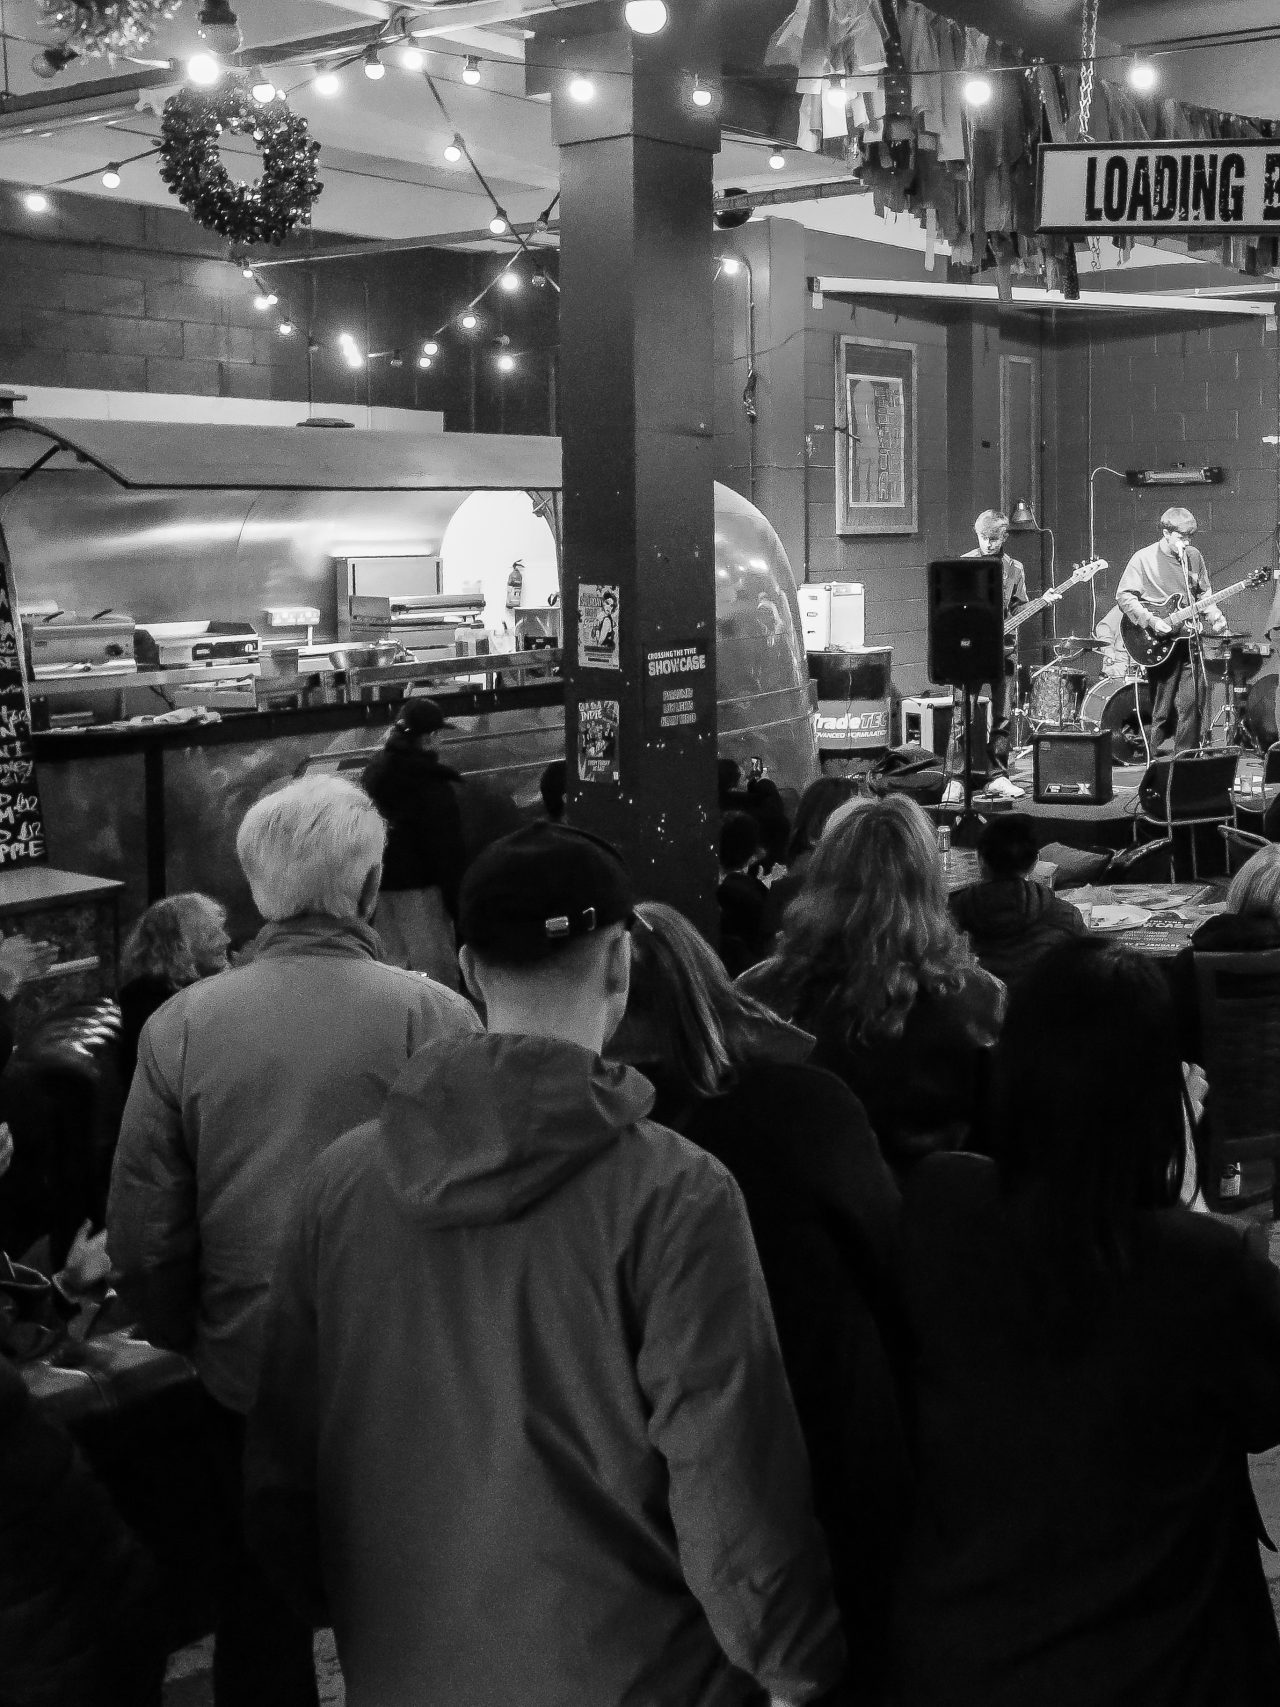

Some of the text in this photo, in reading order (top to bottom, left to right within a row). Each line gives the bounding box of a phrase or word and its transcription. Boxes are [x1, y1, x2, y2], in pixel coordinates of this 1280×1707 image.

[1085, 153, 1246, 222] LOADING
[647, 650, 673, 660] CROSSING
[673, 649, 684, 657] THE
[648, 654, 706, 677] SHOWCASE
[847, 729, 887, 738] FORMULATIO
